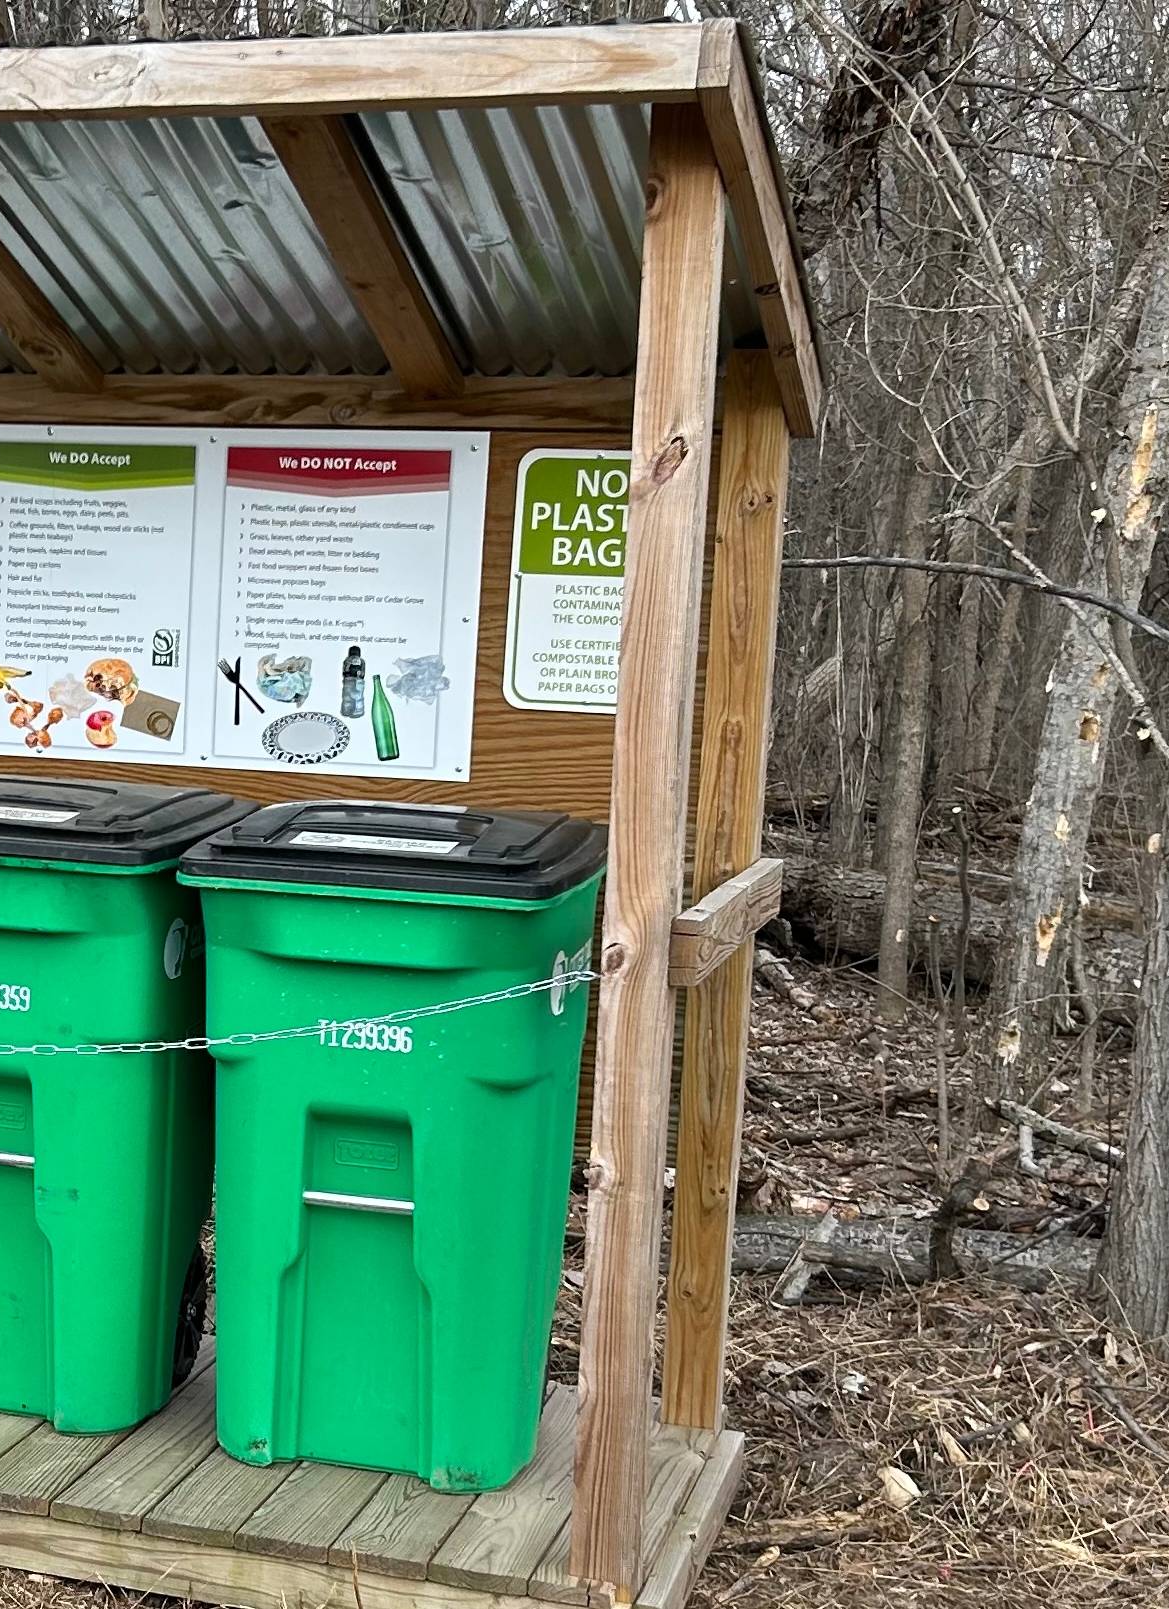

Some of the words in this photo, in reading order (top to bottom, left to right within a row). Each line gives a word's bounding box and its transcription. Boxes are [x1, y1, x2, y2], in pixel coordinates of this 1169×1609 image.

[48, 452, 67, 464] We
[70, 452, 89, 464] DO
[91, 453, 131, 467] Accept
[279, 457, 298, 469] We
[301, 457, 321, 469] DO
[323, 457, 352, 470] NOT
[355, 459, 397, 473] Accept
[576, 469, 628, 498] NO
[532, 502, 628, 532] PLAST
[552, 537, 625, 568] BAG
[555, 584, 602, 596] PLASTIC
[552, 599, 624, 610] CONTAMINA
[552, 614, 574, 624] THE
[576, 614, 622, 626] COMPO
[550, 639, 572, 649] USE
[574, 640, 622, 651] CERTIFIE
[154, 655, 170, 664] BPI
[532, 652, 614, 666] COMPOSTABLE
[540, 668, 556, 678] OR
[558, 668, 592, 679] PLAIN
[594, 670, 618, 680] BRO
[538, 682, 572, 692] PAPER
[575, 683, 604, 694] BAGS
